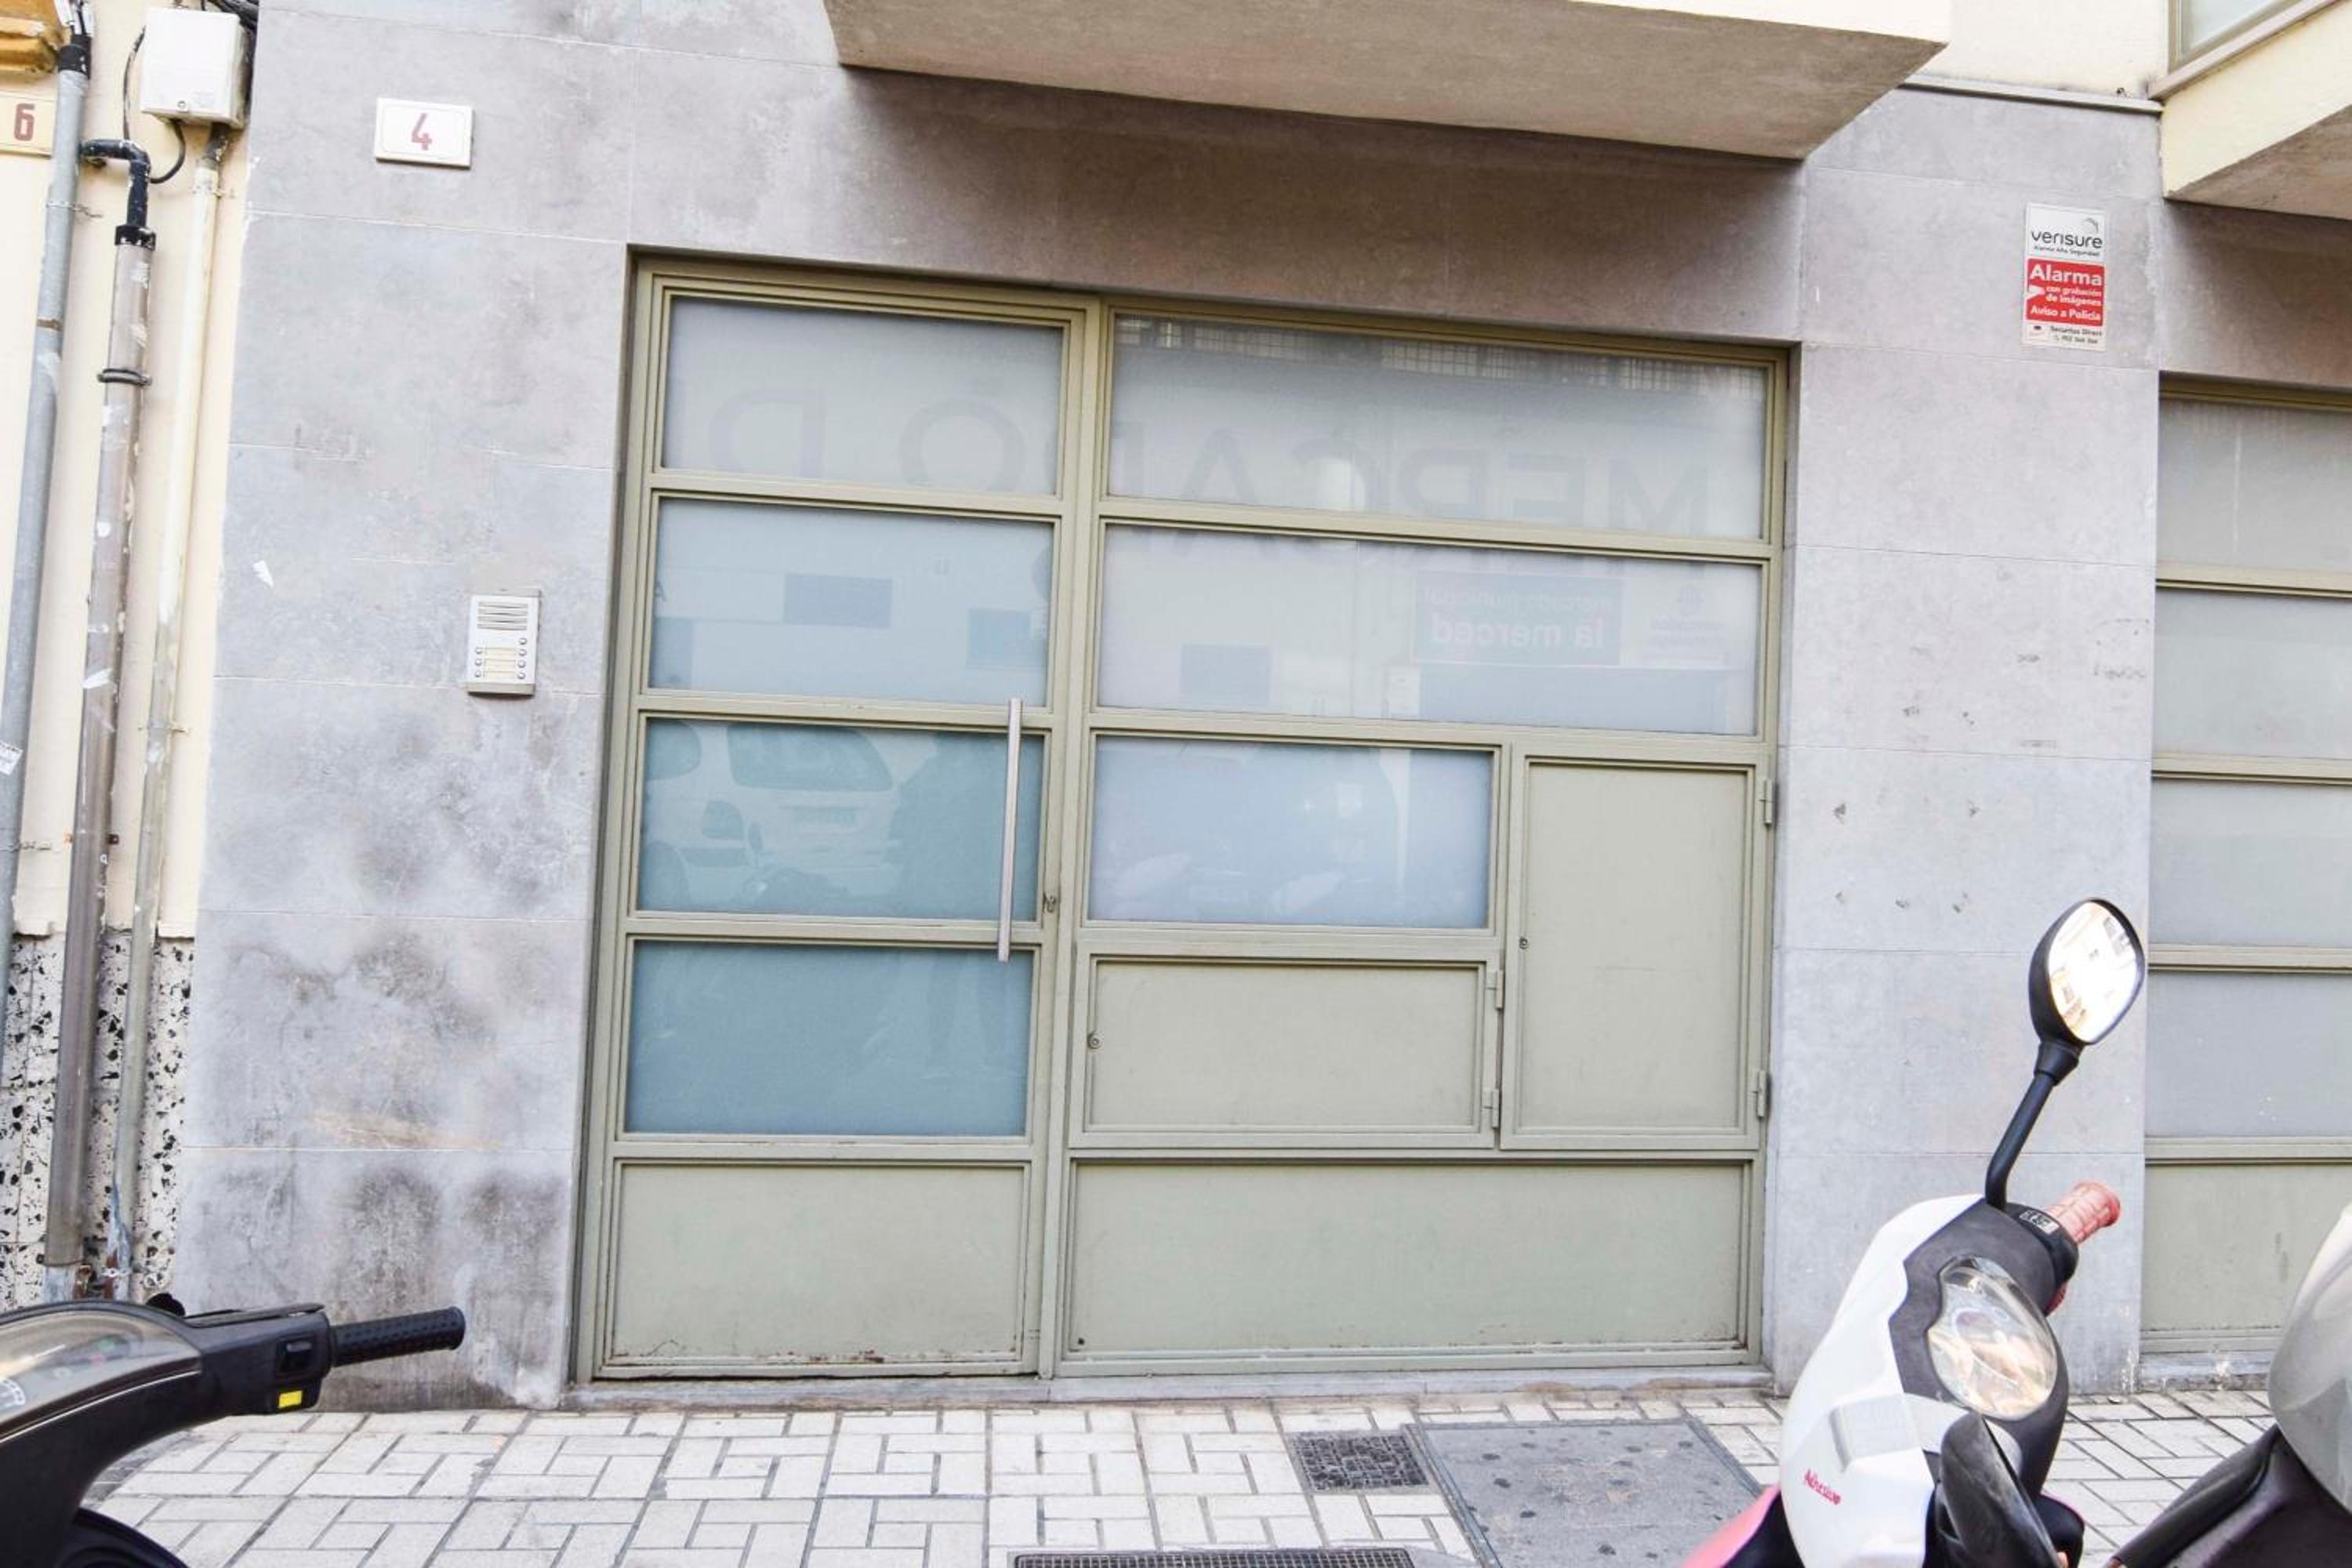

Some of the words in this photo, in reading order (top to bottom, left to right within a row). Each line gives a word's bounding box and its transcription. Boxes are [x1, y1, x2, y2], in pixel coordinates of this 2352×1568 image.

[13, 103, 35, 141] 6
[412, 113, 433, 151] 4
[2031, 231, 2103, 249] verisure
[2031, 263, 2102, 286] Alarma
[2045, 294, 2058, 303] de
[2031, 305, 2058, 316] Aviso
